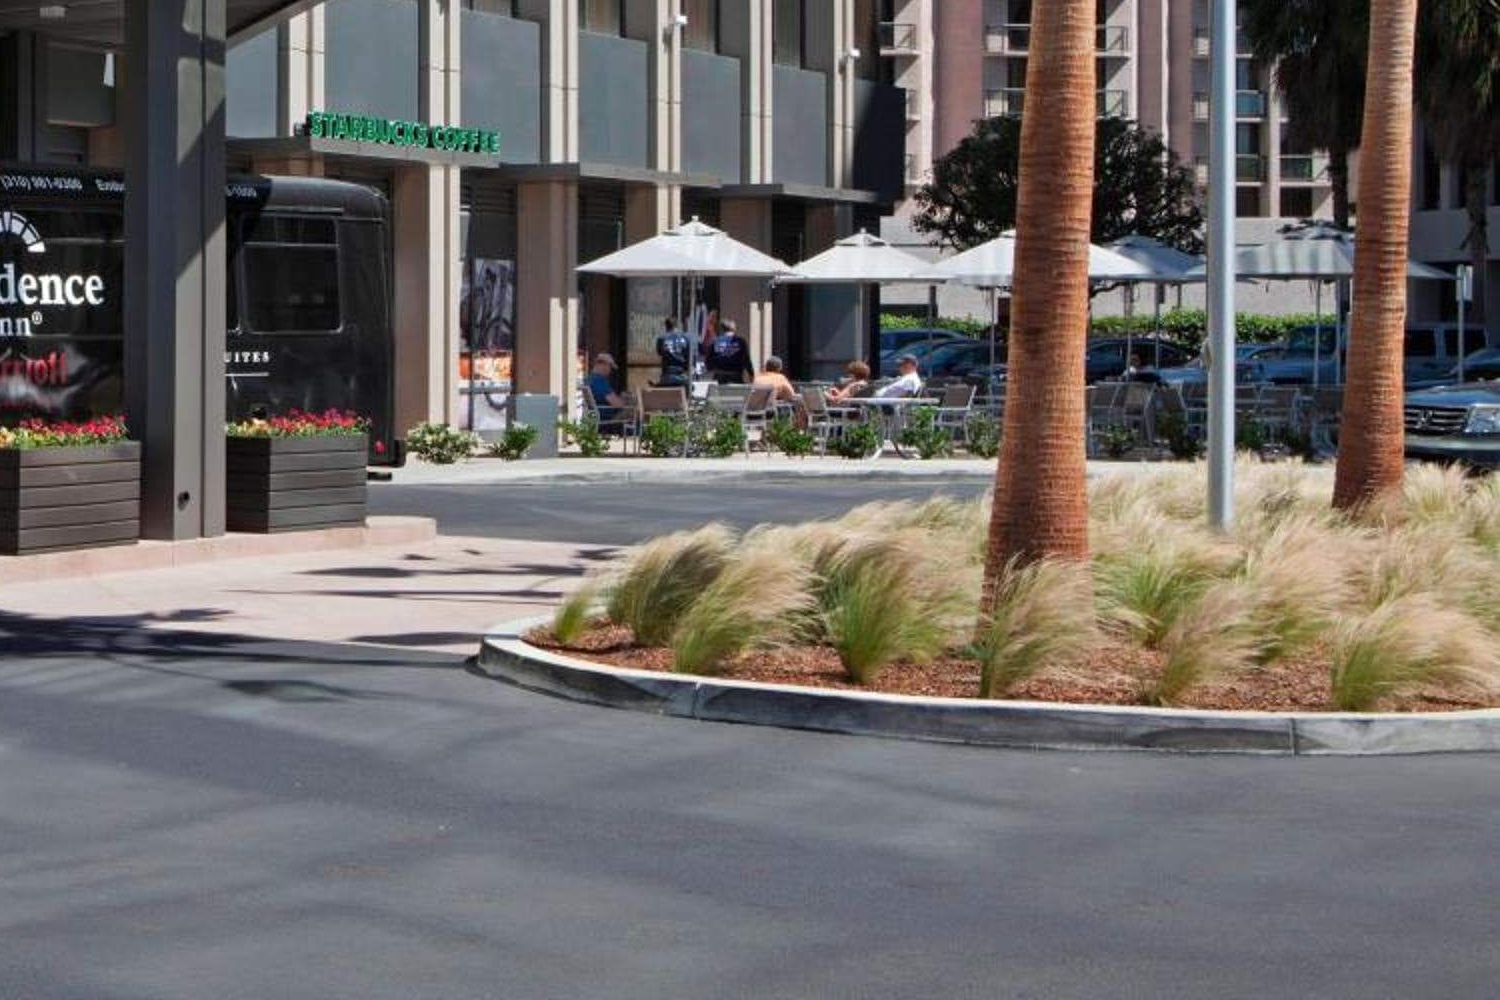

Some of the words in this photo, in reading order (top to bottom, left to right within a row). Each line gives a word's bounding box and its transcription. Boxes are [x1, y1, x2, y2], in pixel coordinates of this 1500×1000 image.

[308, 110, 428, 148] STARBUCKS
[431, 123, 500, 153] COFFEE
[222, 351, 270, 363] UITES
